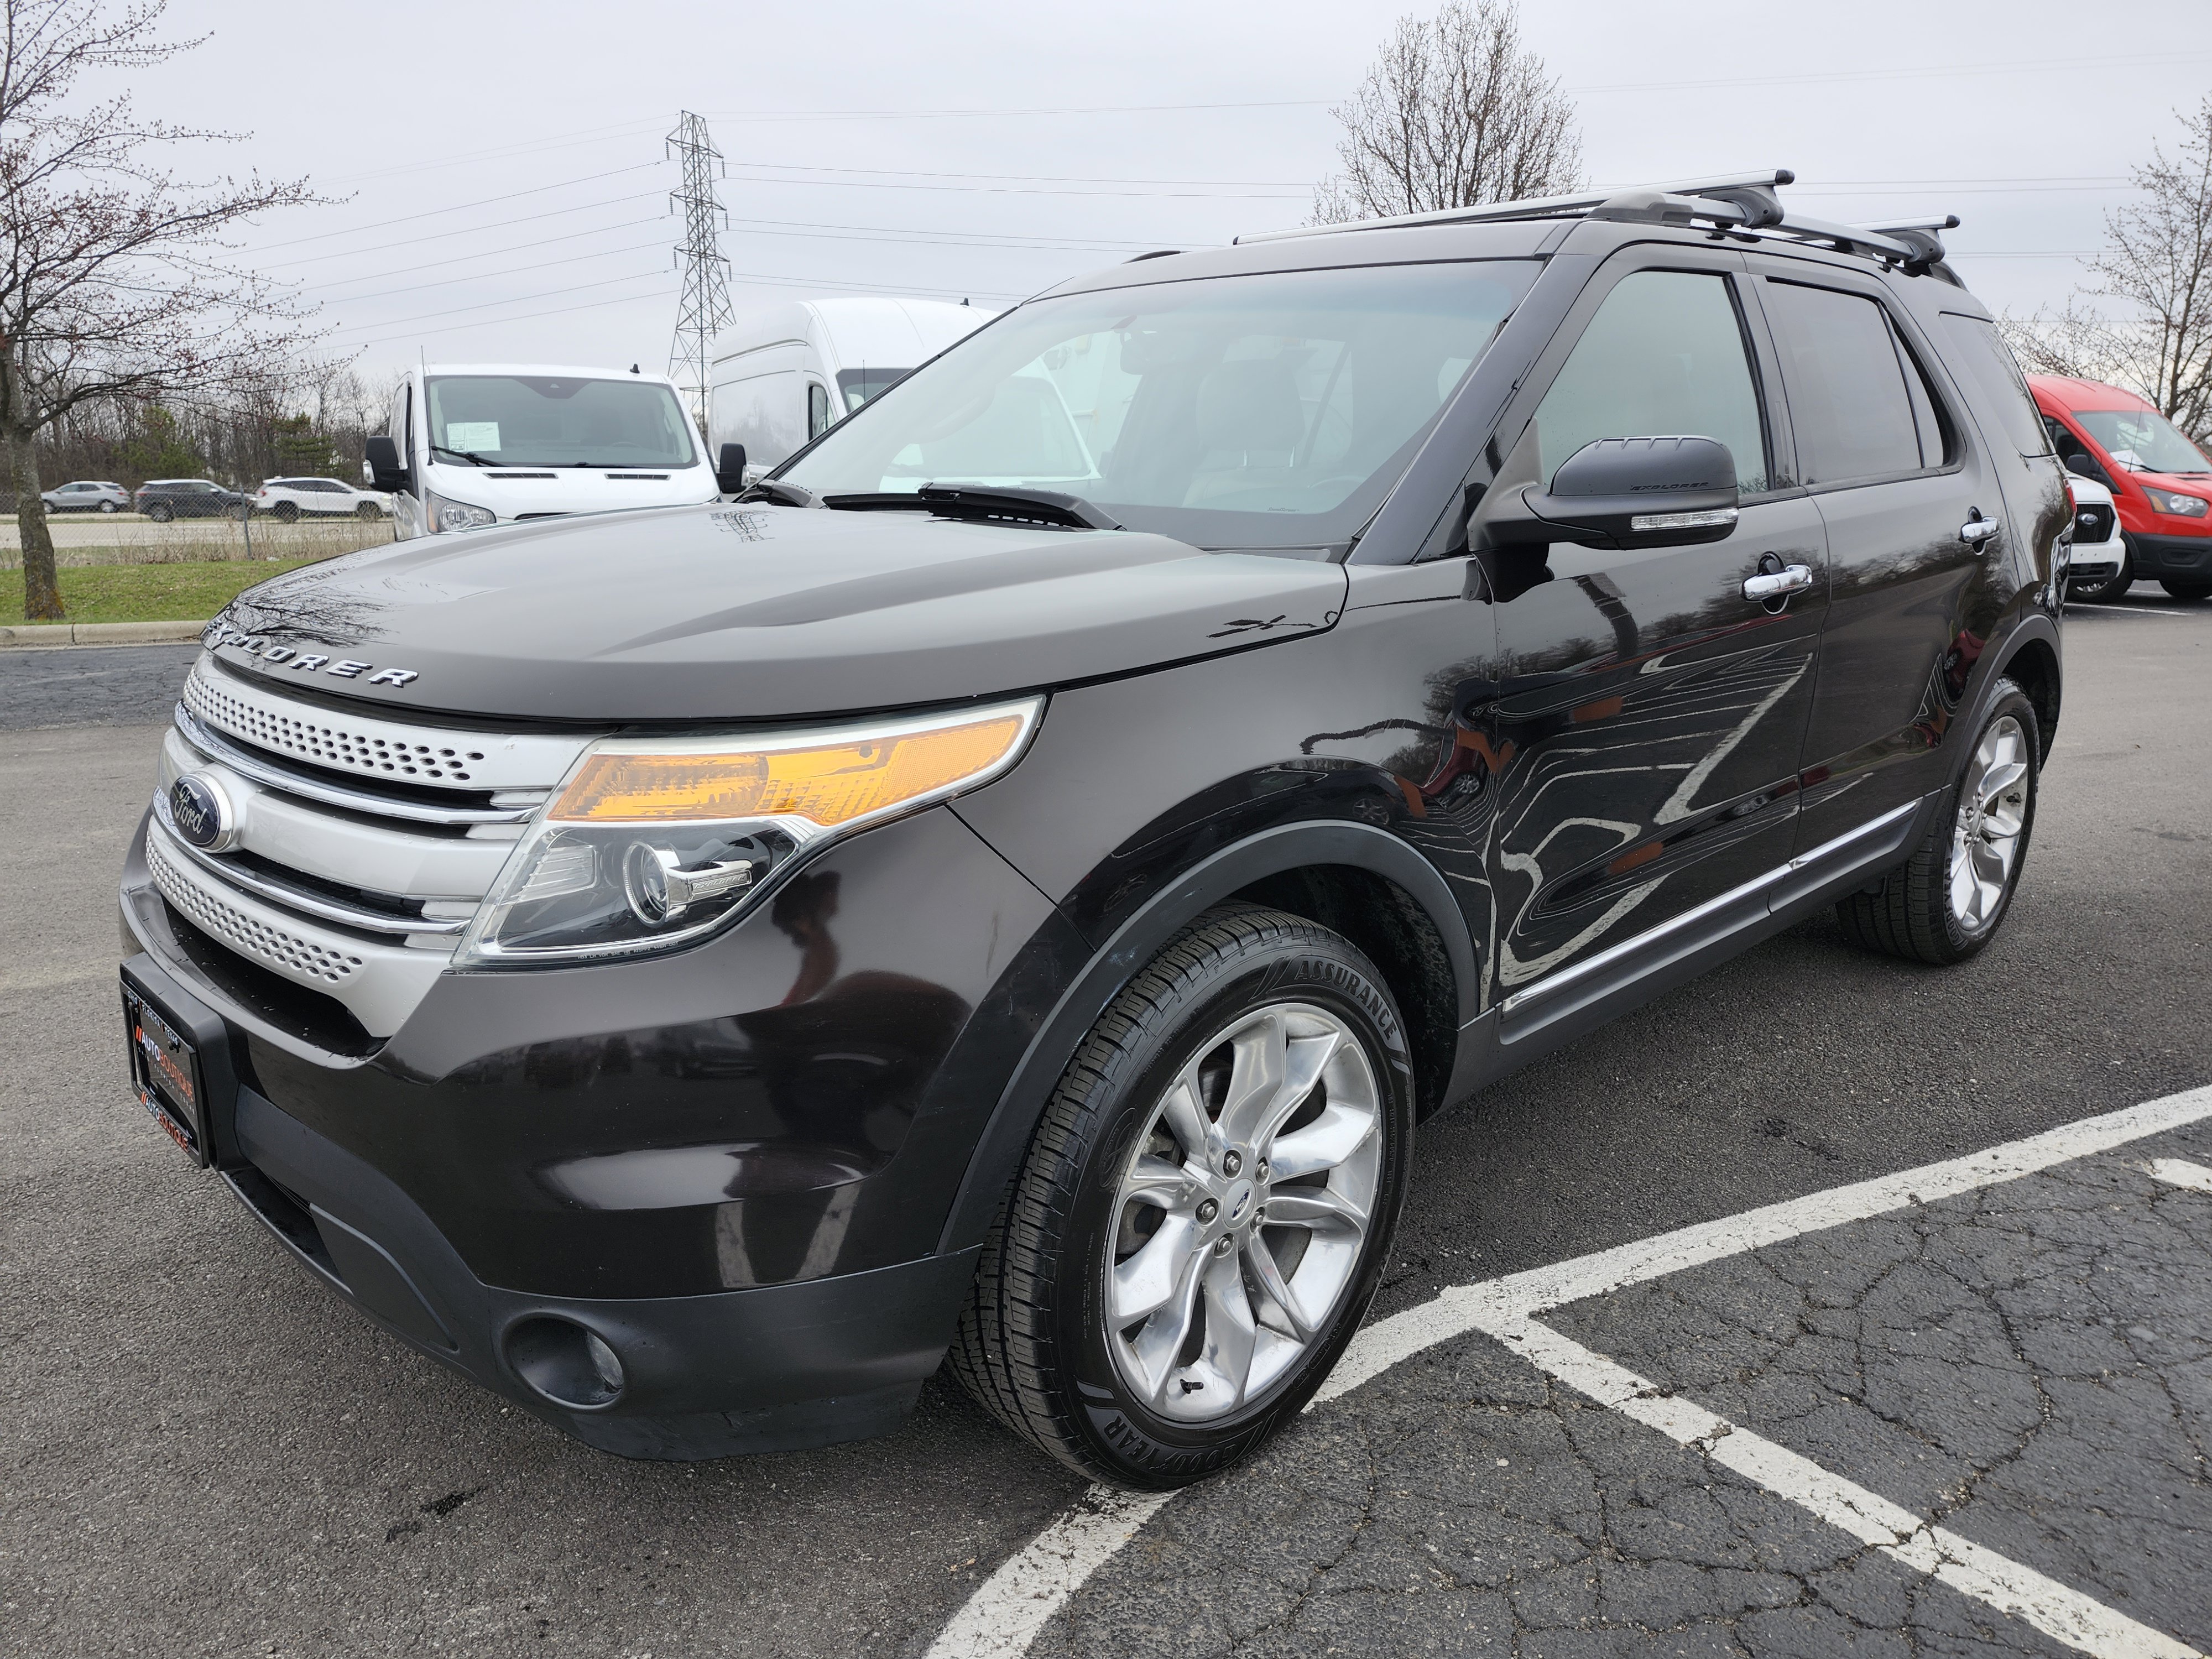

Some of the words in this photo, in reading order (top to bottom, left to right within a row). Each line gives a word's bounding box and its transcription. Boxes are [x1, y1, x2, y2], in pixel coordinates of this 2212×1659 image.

[1630, 482, 1709, 491] EXPLORER
[206, 618, 419, 688] EXPLORER
[174, 783, 208, 834] Ford
[693, 874, 746, 889] EXPLORER
[1294, 960, 1397, 1041] ASSURANCE
[141, 1031, 194, 1102] AUTOBOUTIQUE
[145, 1097, 190, 1153] AUTOBOUTIQUE
[1104, 1415, 1238, 1472] GOODYEAR
